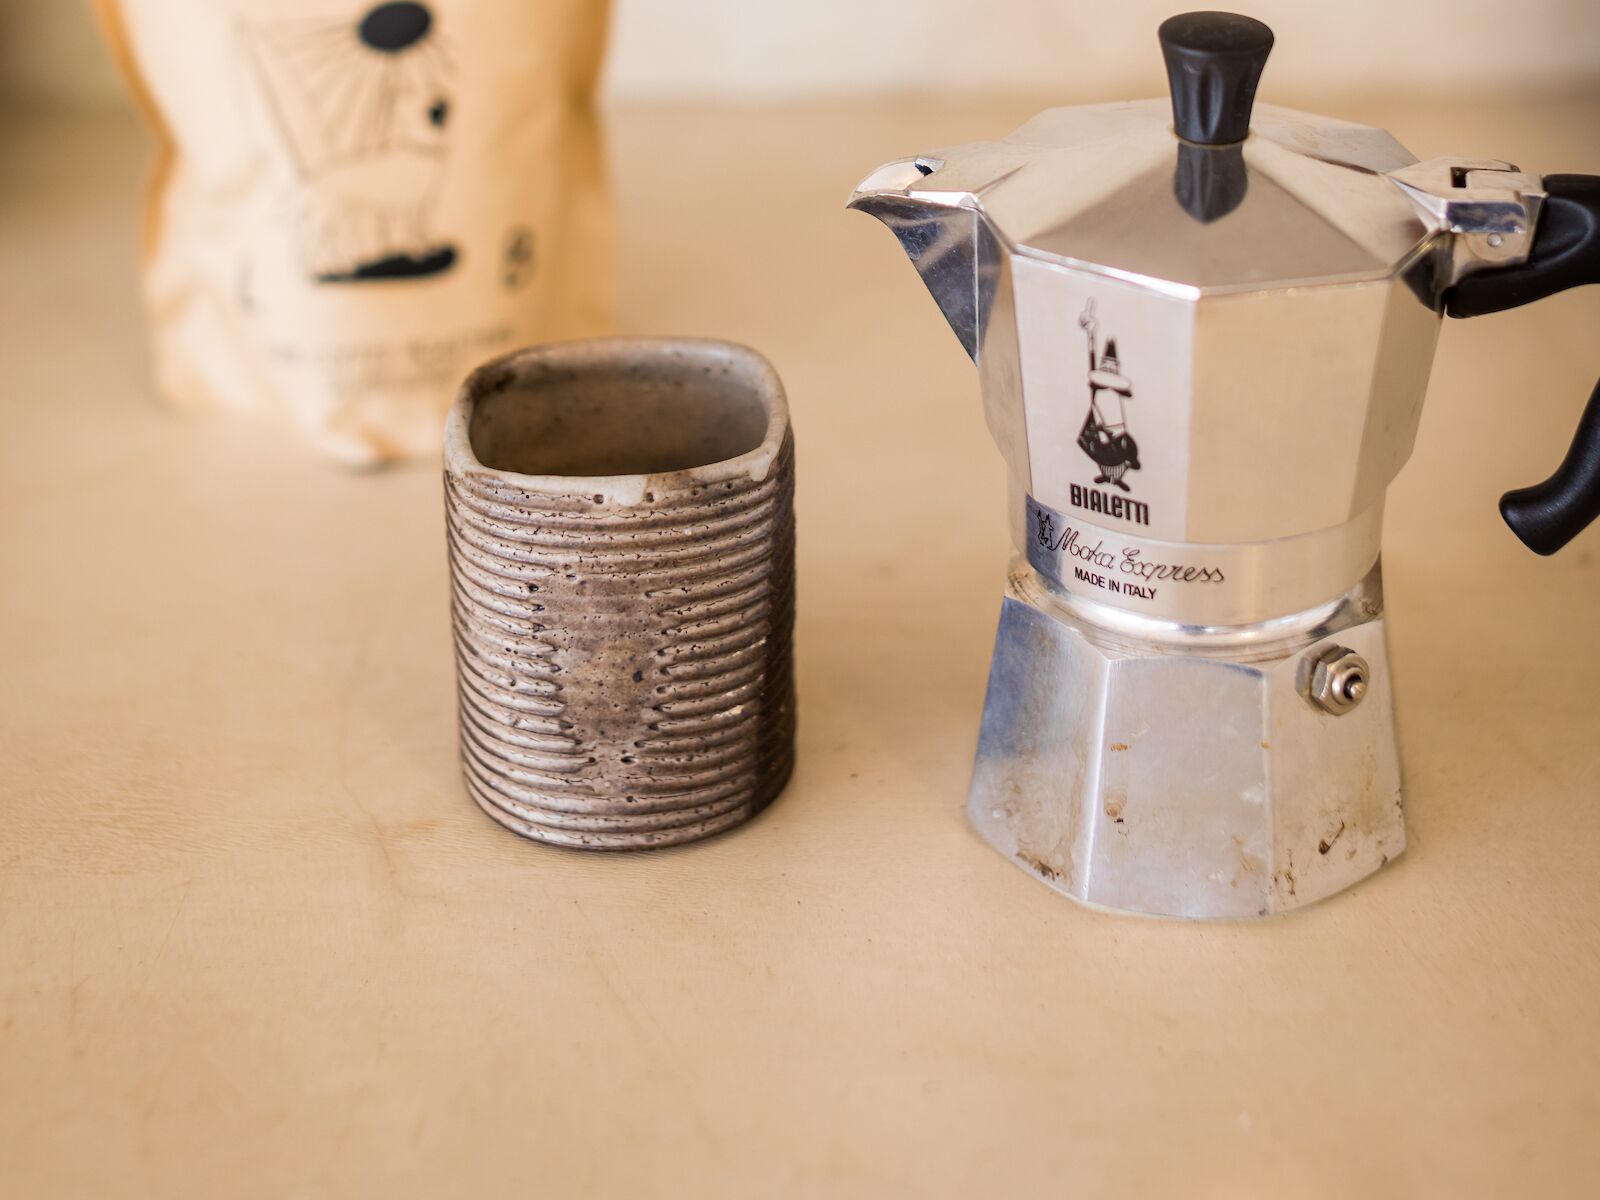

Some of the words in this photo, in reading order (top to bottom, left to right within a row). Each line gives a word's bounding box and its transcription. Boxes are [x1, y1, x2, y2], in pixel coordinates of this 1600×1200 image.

[1054, 527, 1114, 569] Moka
[1120, 547, 1225, 582] Express
[1074, 567, 1105, 588] MADE
[1109, 579, 1120, 593] IN
[1123, 583, 1157, 600] ITALY
